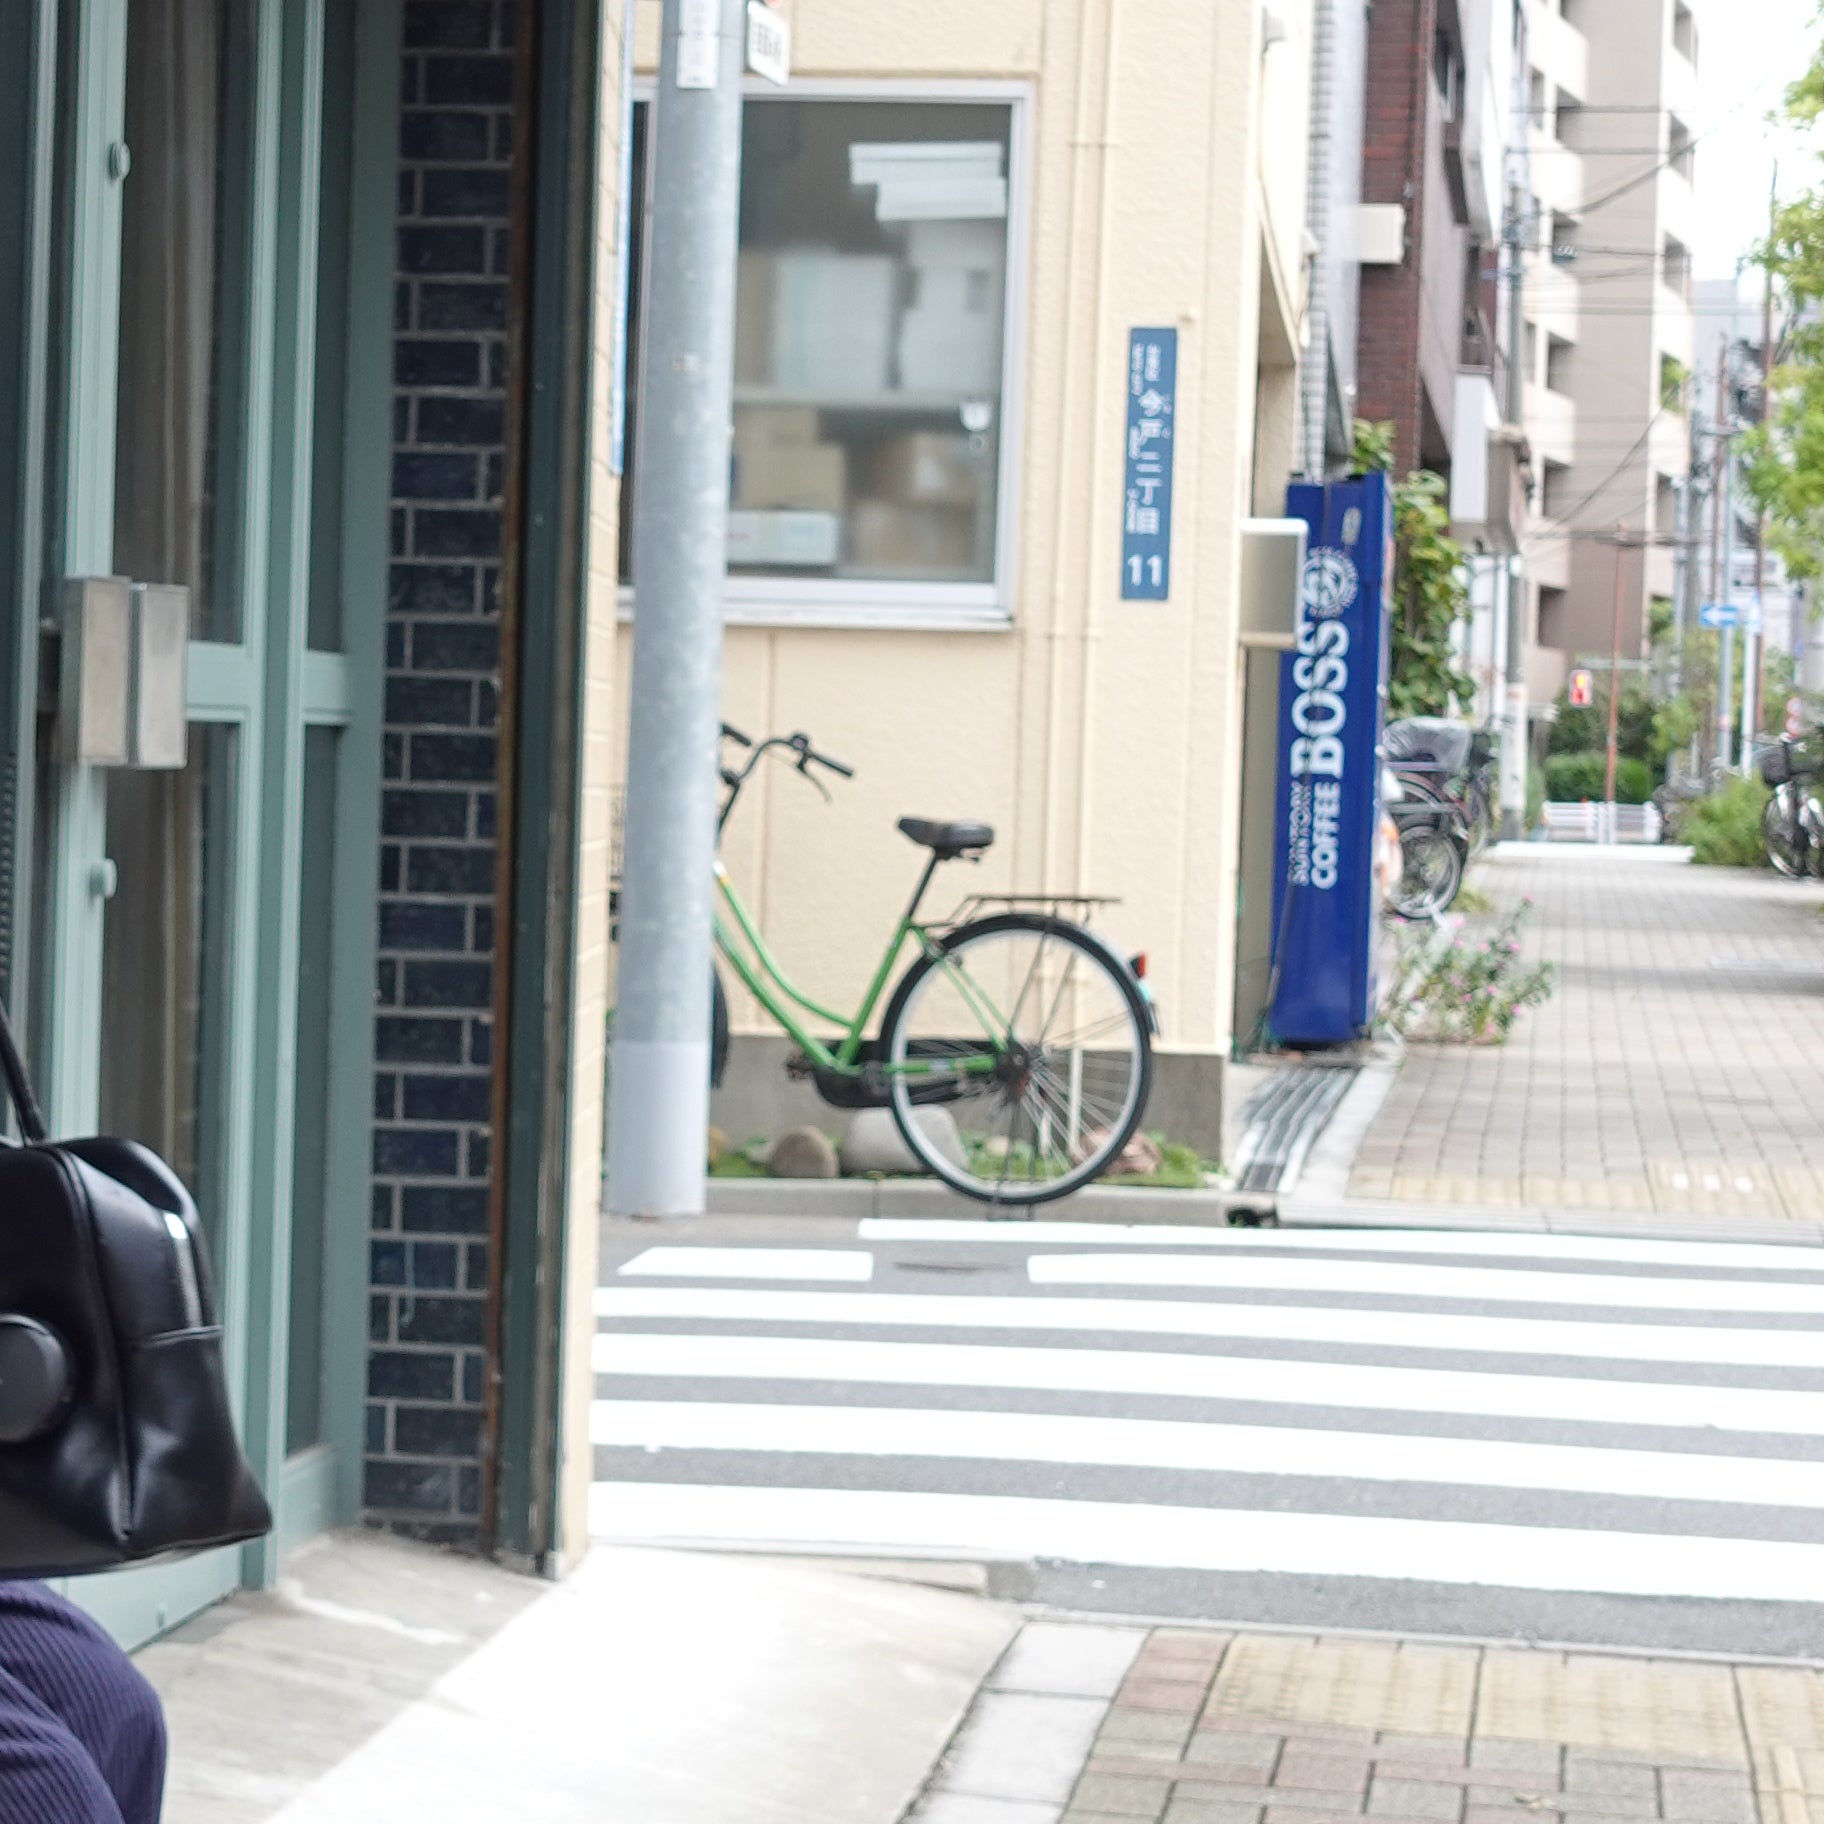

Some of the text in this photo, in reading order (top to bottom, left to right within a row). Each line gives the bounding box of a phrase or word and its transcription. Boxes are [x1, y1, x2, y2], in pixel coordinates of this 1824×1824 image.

[1127, 554, 1162, 587] 11
[1290, 619, 1350, 779] BOSS
[1311, 781, 1341, 890] COFFEE
